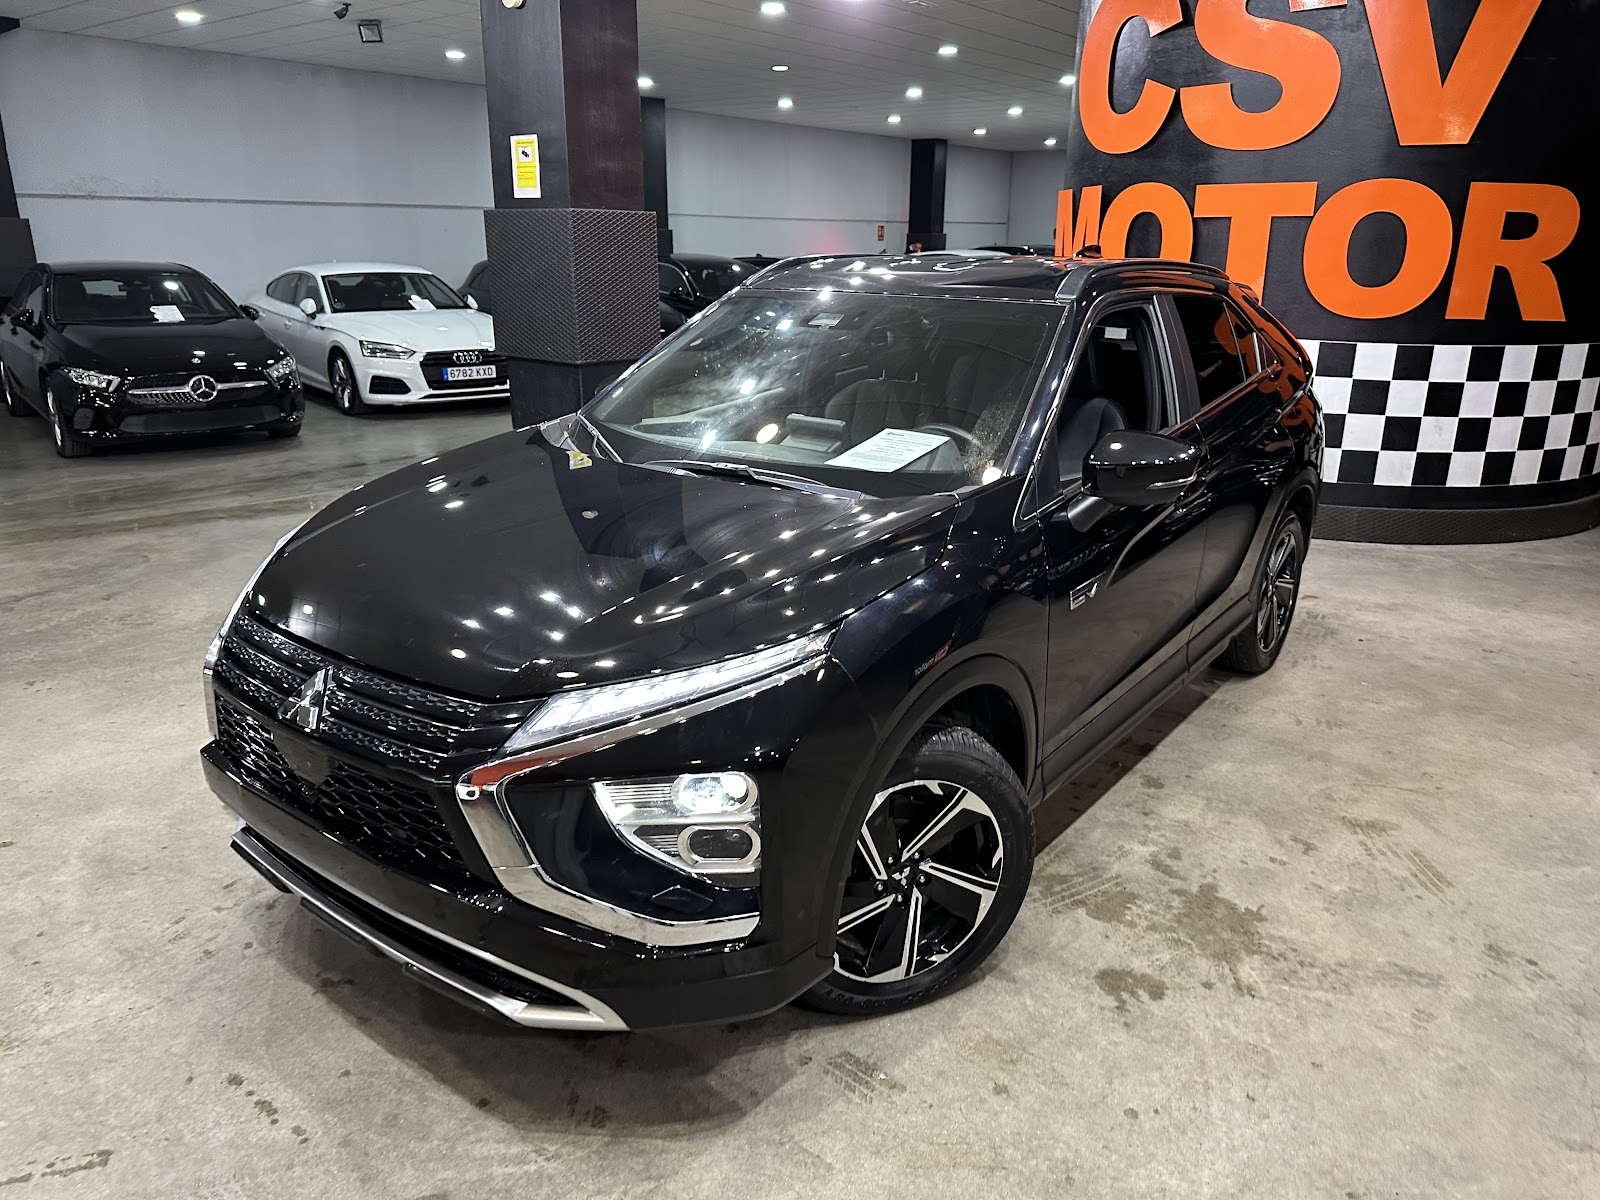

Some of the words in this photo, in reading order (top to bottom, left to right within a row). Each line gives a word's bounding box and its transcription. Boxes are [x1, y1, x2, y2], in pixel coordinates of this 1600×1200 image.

[1078, 0, 1540, 154] CSV
[450, 368, 474, 379] 6782
[476, 367, 493, 377] KXD
